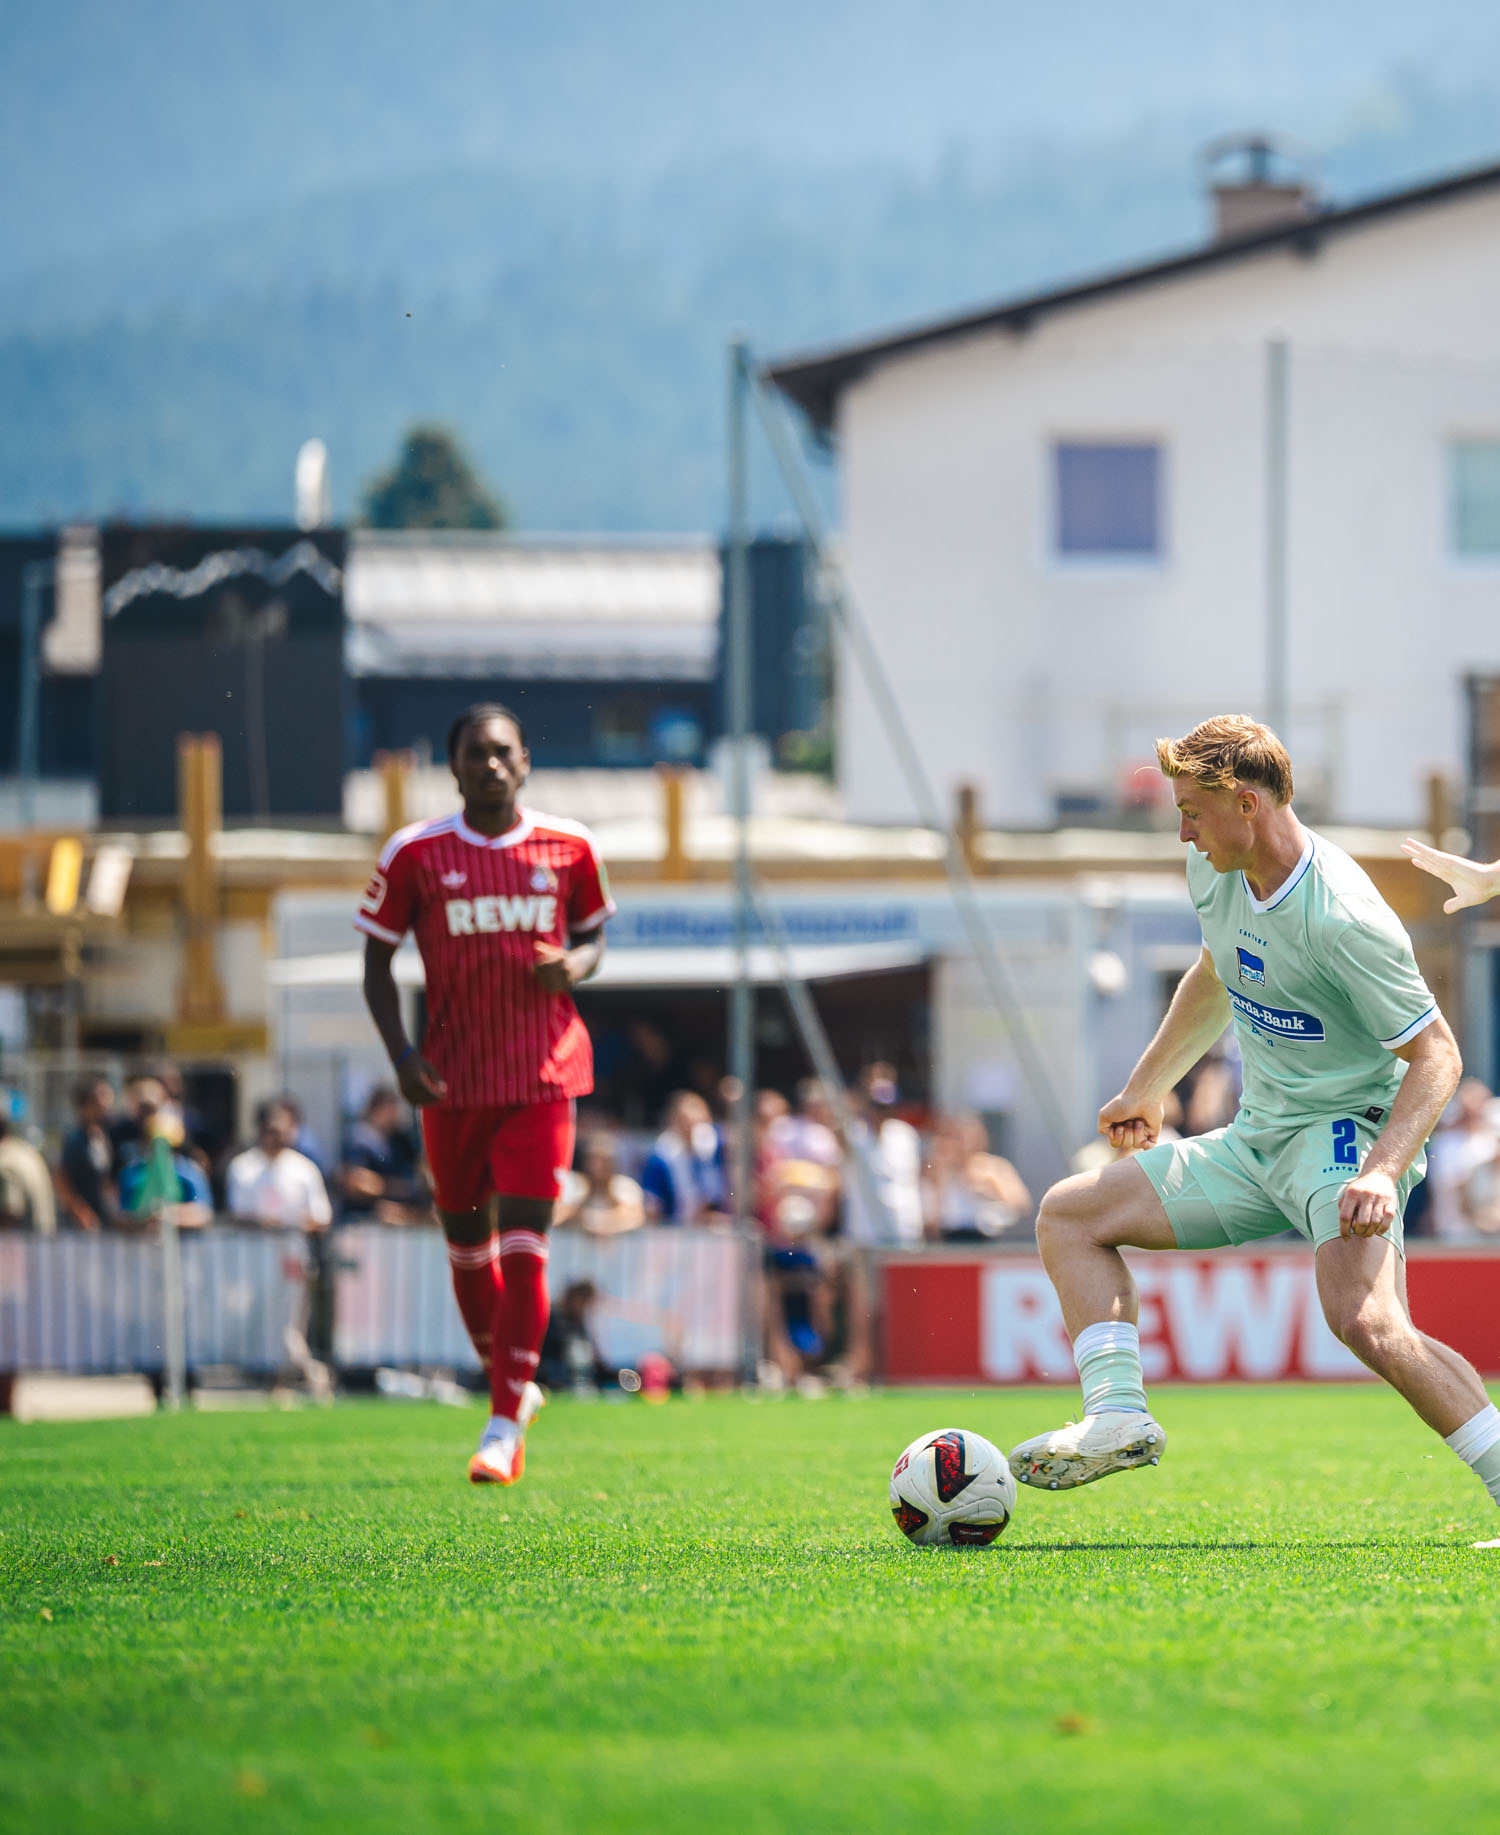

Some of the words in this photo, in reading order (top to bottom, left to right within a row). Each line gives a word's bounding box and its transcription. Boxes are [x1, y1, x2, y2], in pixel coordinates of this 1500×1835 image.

[446, 895, 557, 936] REWE
[1229, 993, 1305, 1031] arda-Bank
[1332, 1118, 1357, 1164] 2
